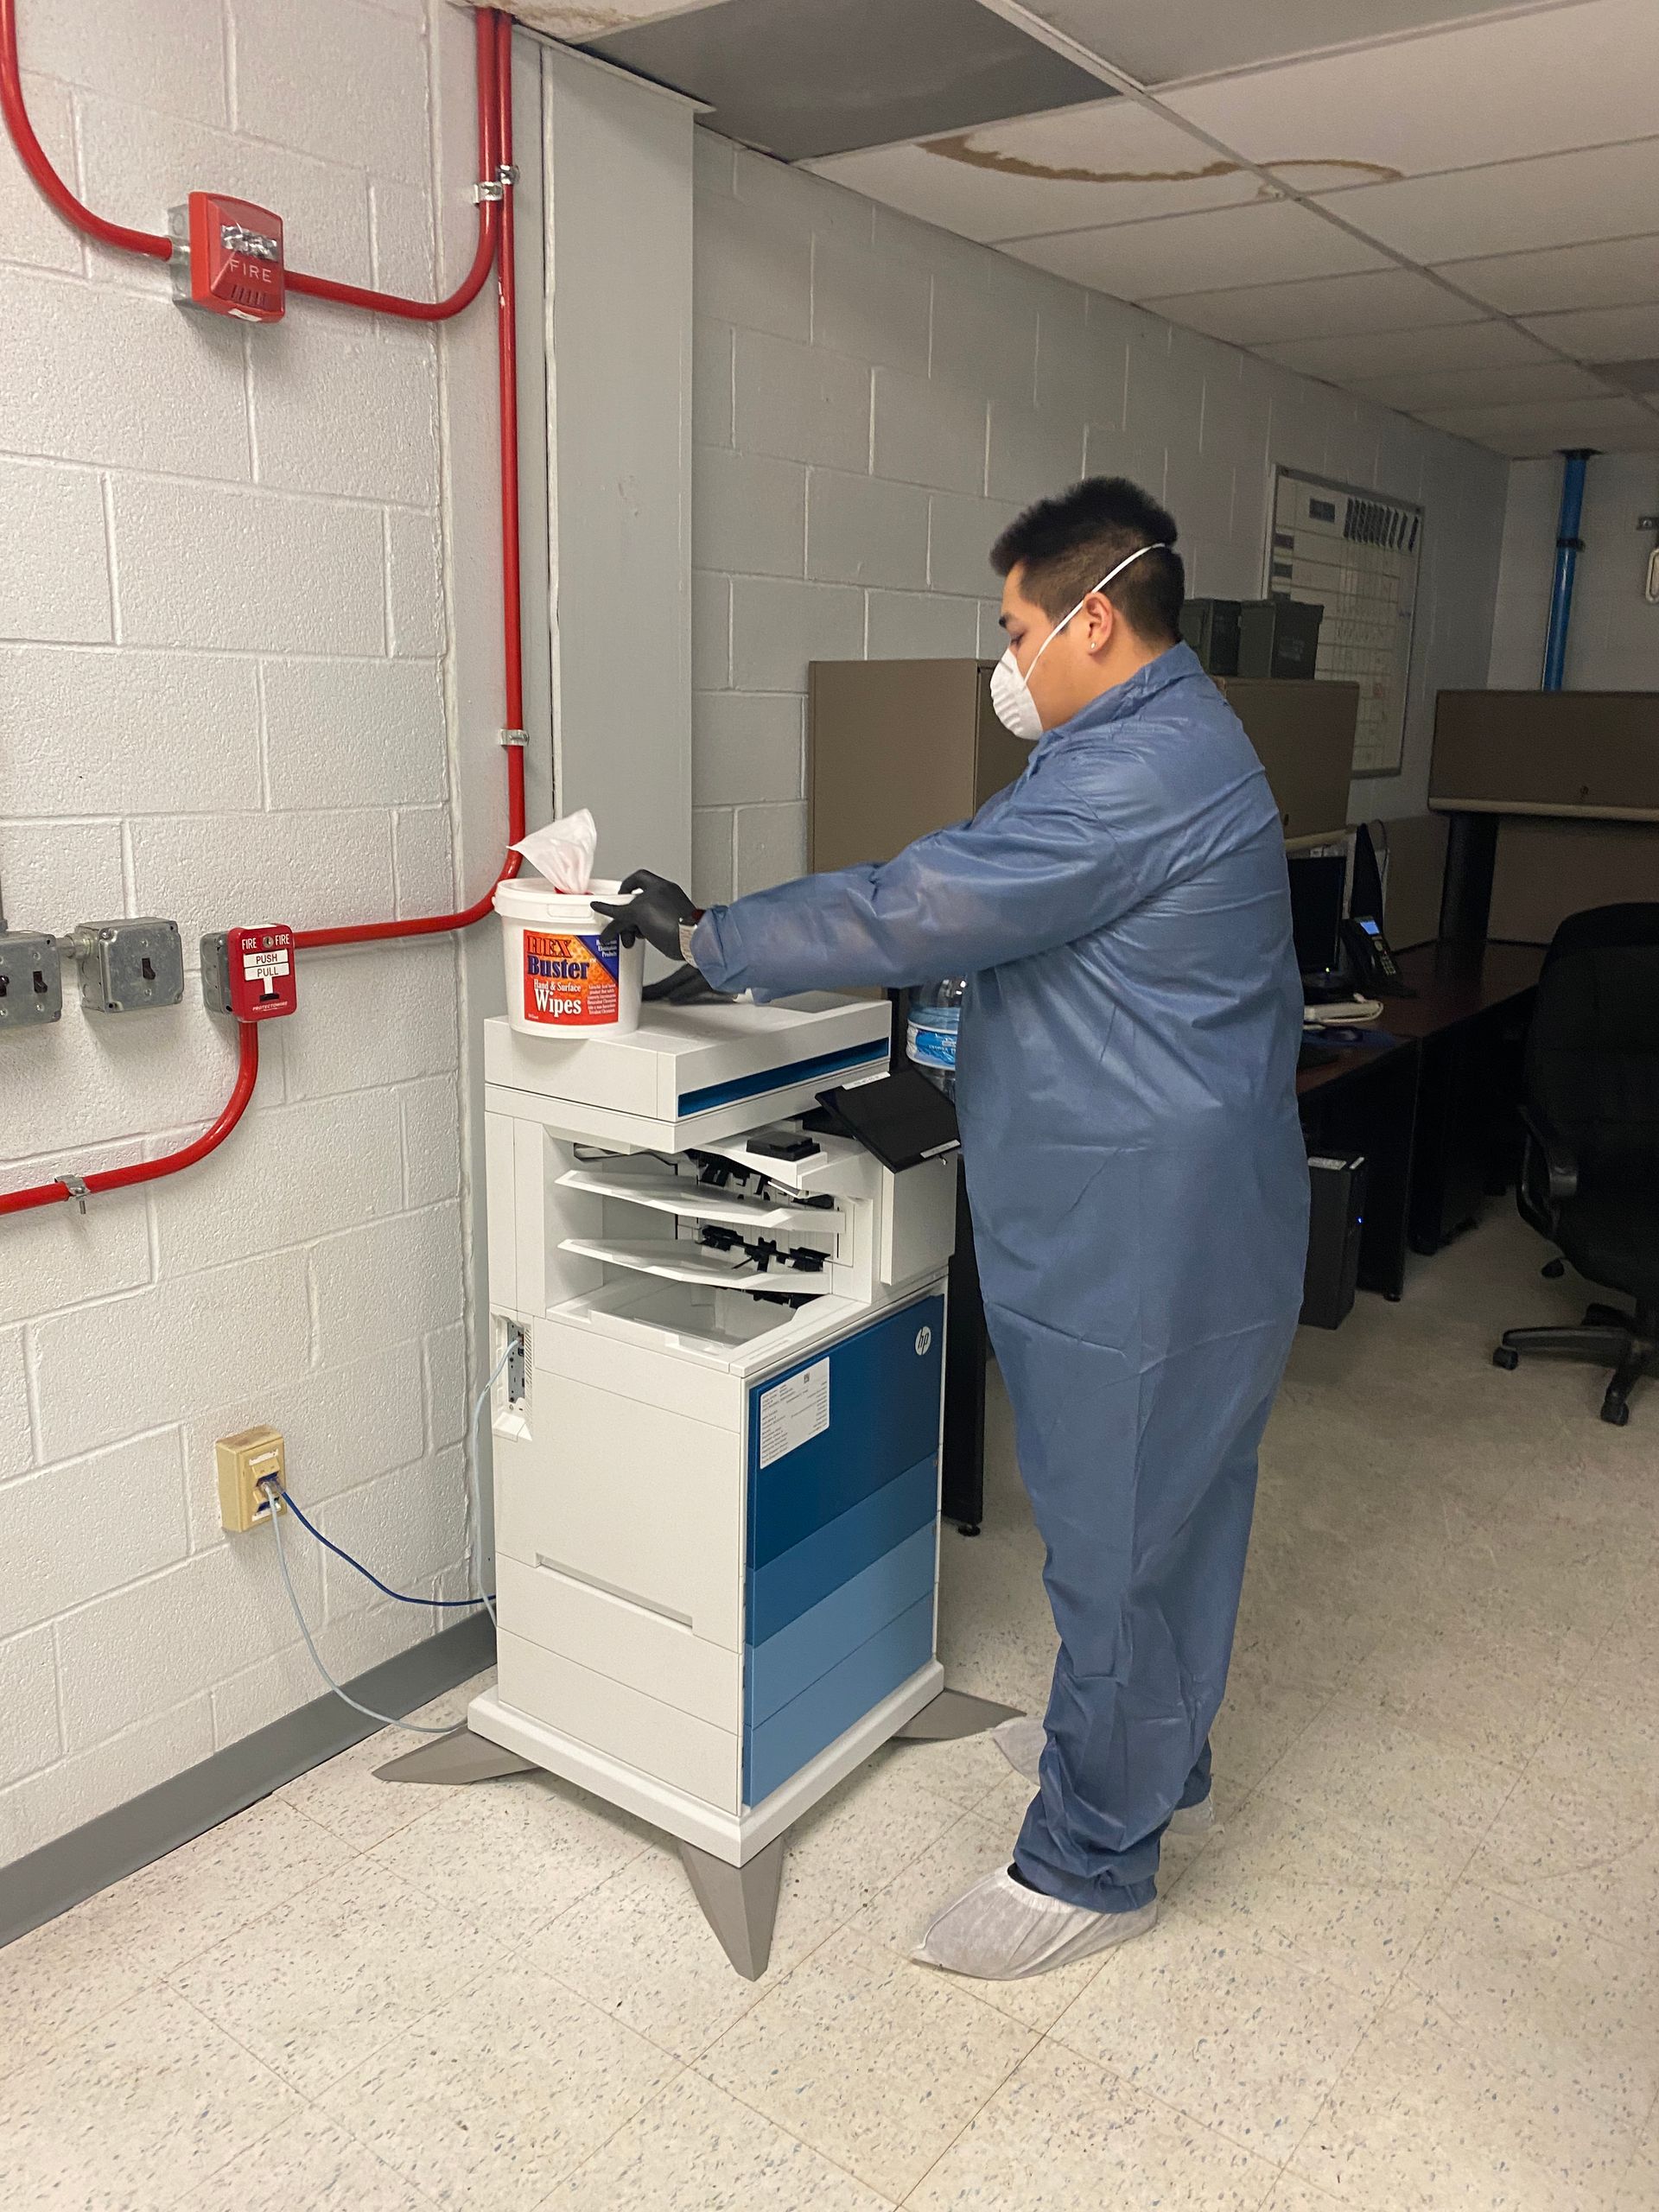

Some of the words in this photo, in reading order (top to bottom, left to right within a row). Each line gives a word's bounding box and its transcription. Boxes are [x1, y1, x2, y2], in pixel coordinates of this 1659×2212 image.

[229, 258, 271, 283] FIRE
[242, 938, 257, 950] FIRE
[275, 934, 289, 946] FIRE
[527, 936, 572, 958] HEX
[256, 953, 277, 964] PUSH
[257, 967, 278, 977] PULL
[527, 955, 589, 980] Buster
[534, 979, 549, 989] Hand
[550, 982, 556, 991] &
[557, 982, 582, 992] Surface
[534, 988, 582, 1018] Wipes
[917, 1326, 931, 1355] hp
